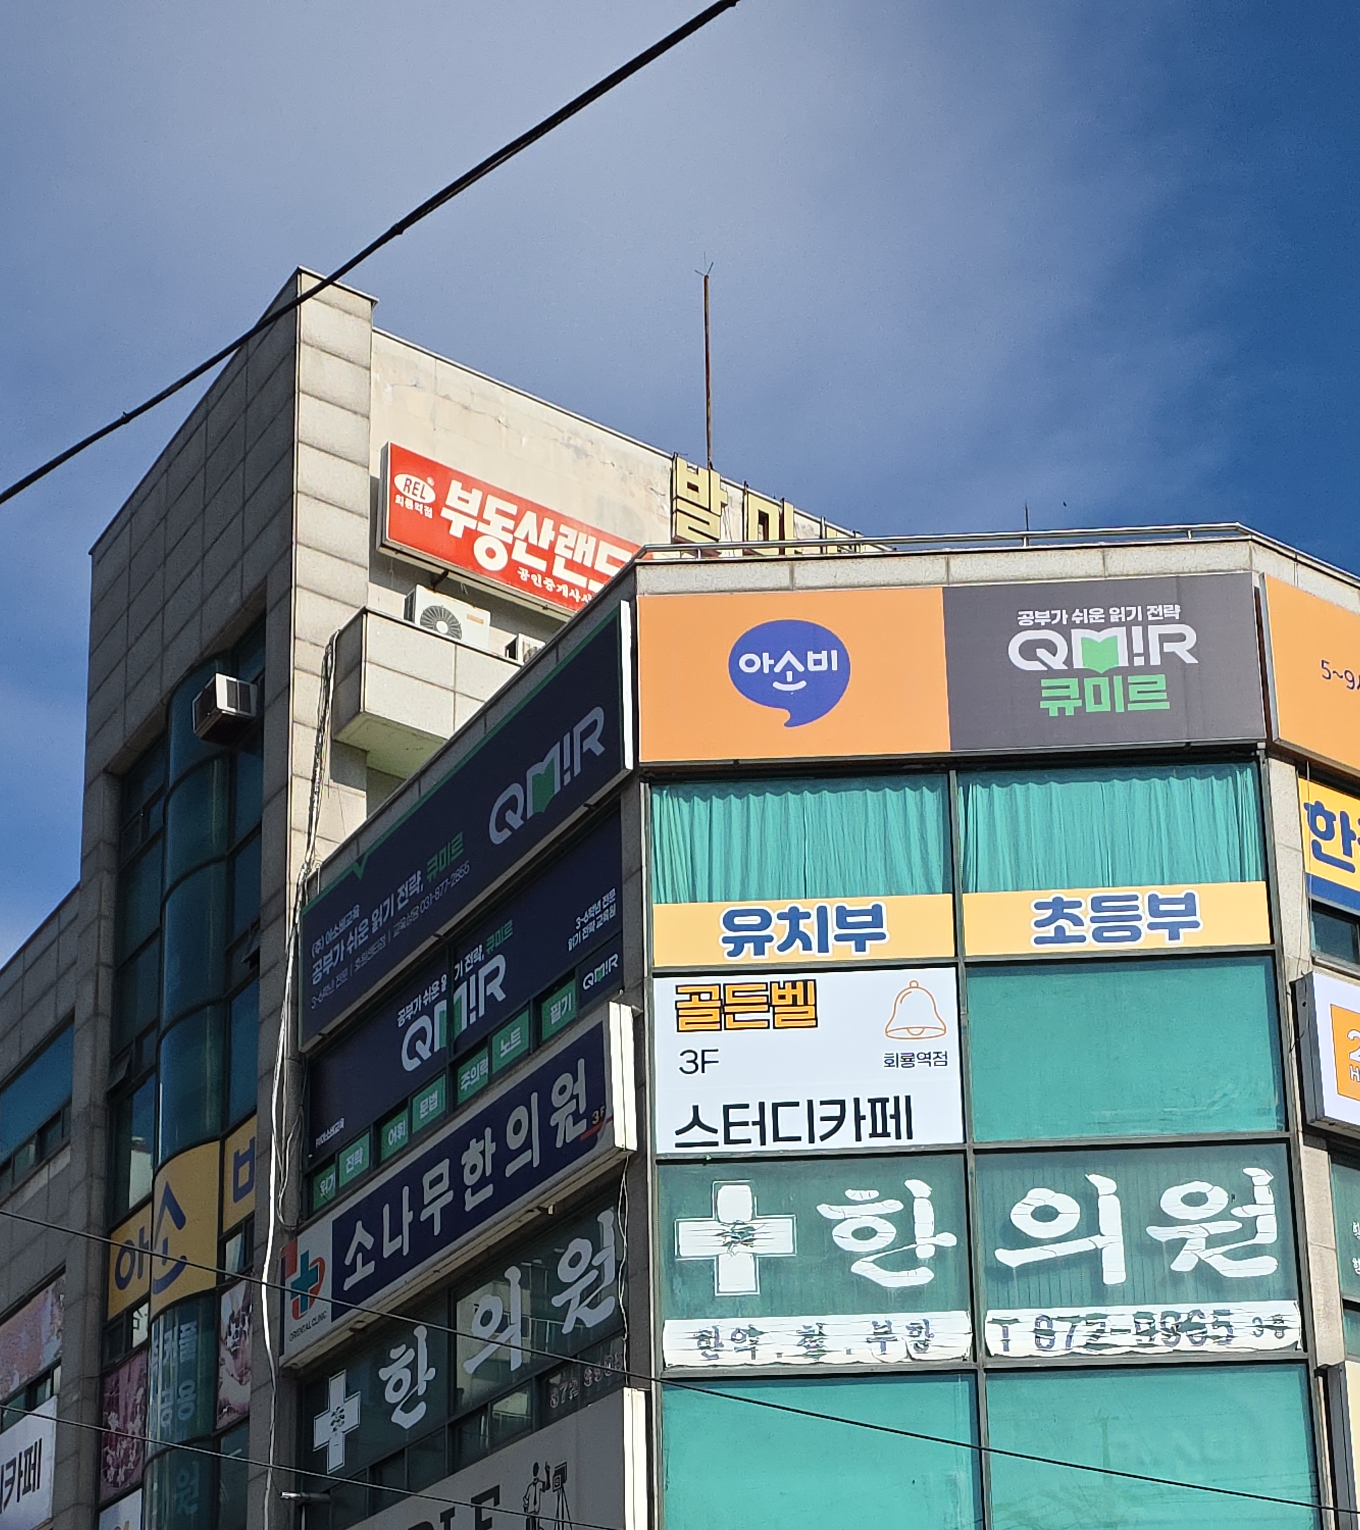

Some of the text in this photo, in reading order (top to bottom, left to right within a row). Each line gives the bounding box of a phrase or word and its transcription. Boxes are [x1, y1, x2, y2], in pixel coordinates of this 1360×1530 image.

[1017, 604, 1181, 626] 공부가 쉬운 읽기 전략
[738, 648, 839, 692] 아소비
[1040, 674, 1170, 716] 큐미르
[312, 939, 346, 987] 공부가
[346, 918, 371, 956] 쉬운
[372, 893, 395, 936] 읽기
[426, 832, 465, 883] 큐미르
[721, 902, 887, 959] 유치부
[1033, 891, 1201, 946] 초등부
[675, 979, 818, 1032] 골든벨
[499, 1027, 523, 1059] 노트
[679, 1048, 719, 1075] 3F
[883, 1051, 948, 1069] 회룡역점
[674, 1096, 914, 1148] 스터디카페
[343, 1058, 587, 1291] 소나무한의원
[817, 1167, 1280, 1289] 한의원
[379, 1209, 616, 1429] 한의원
